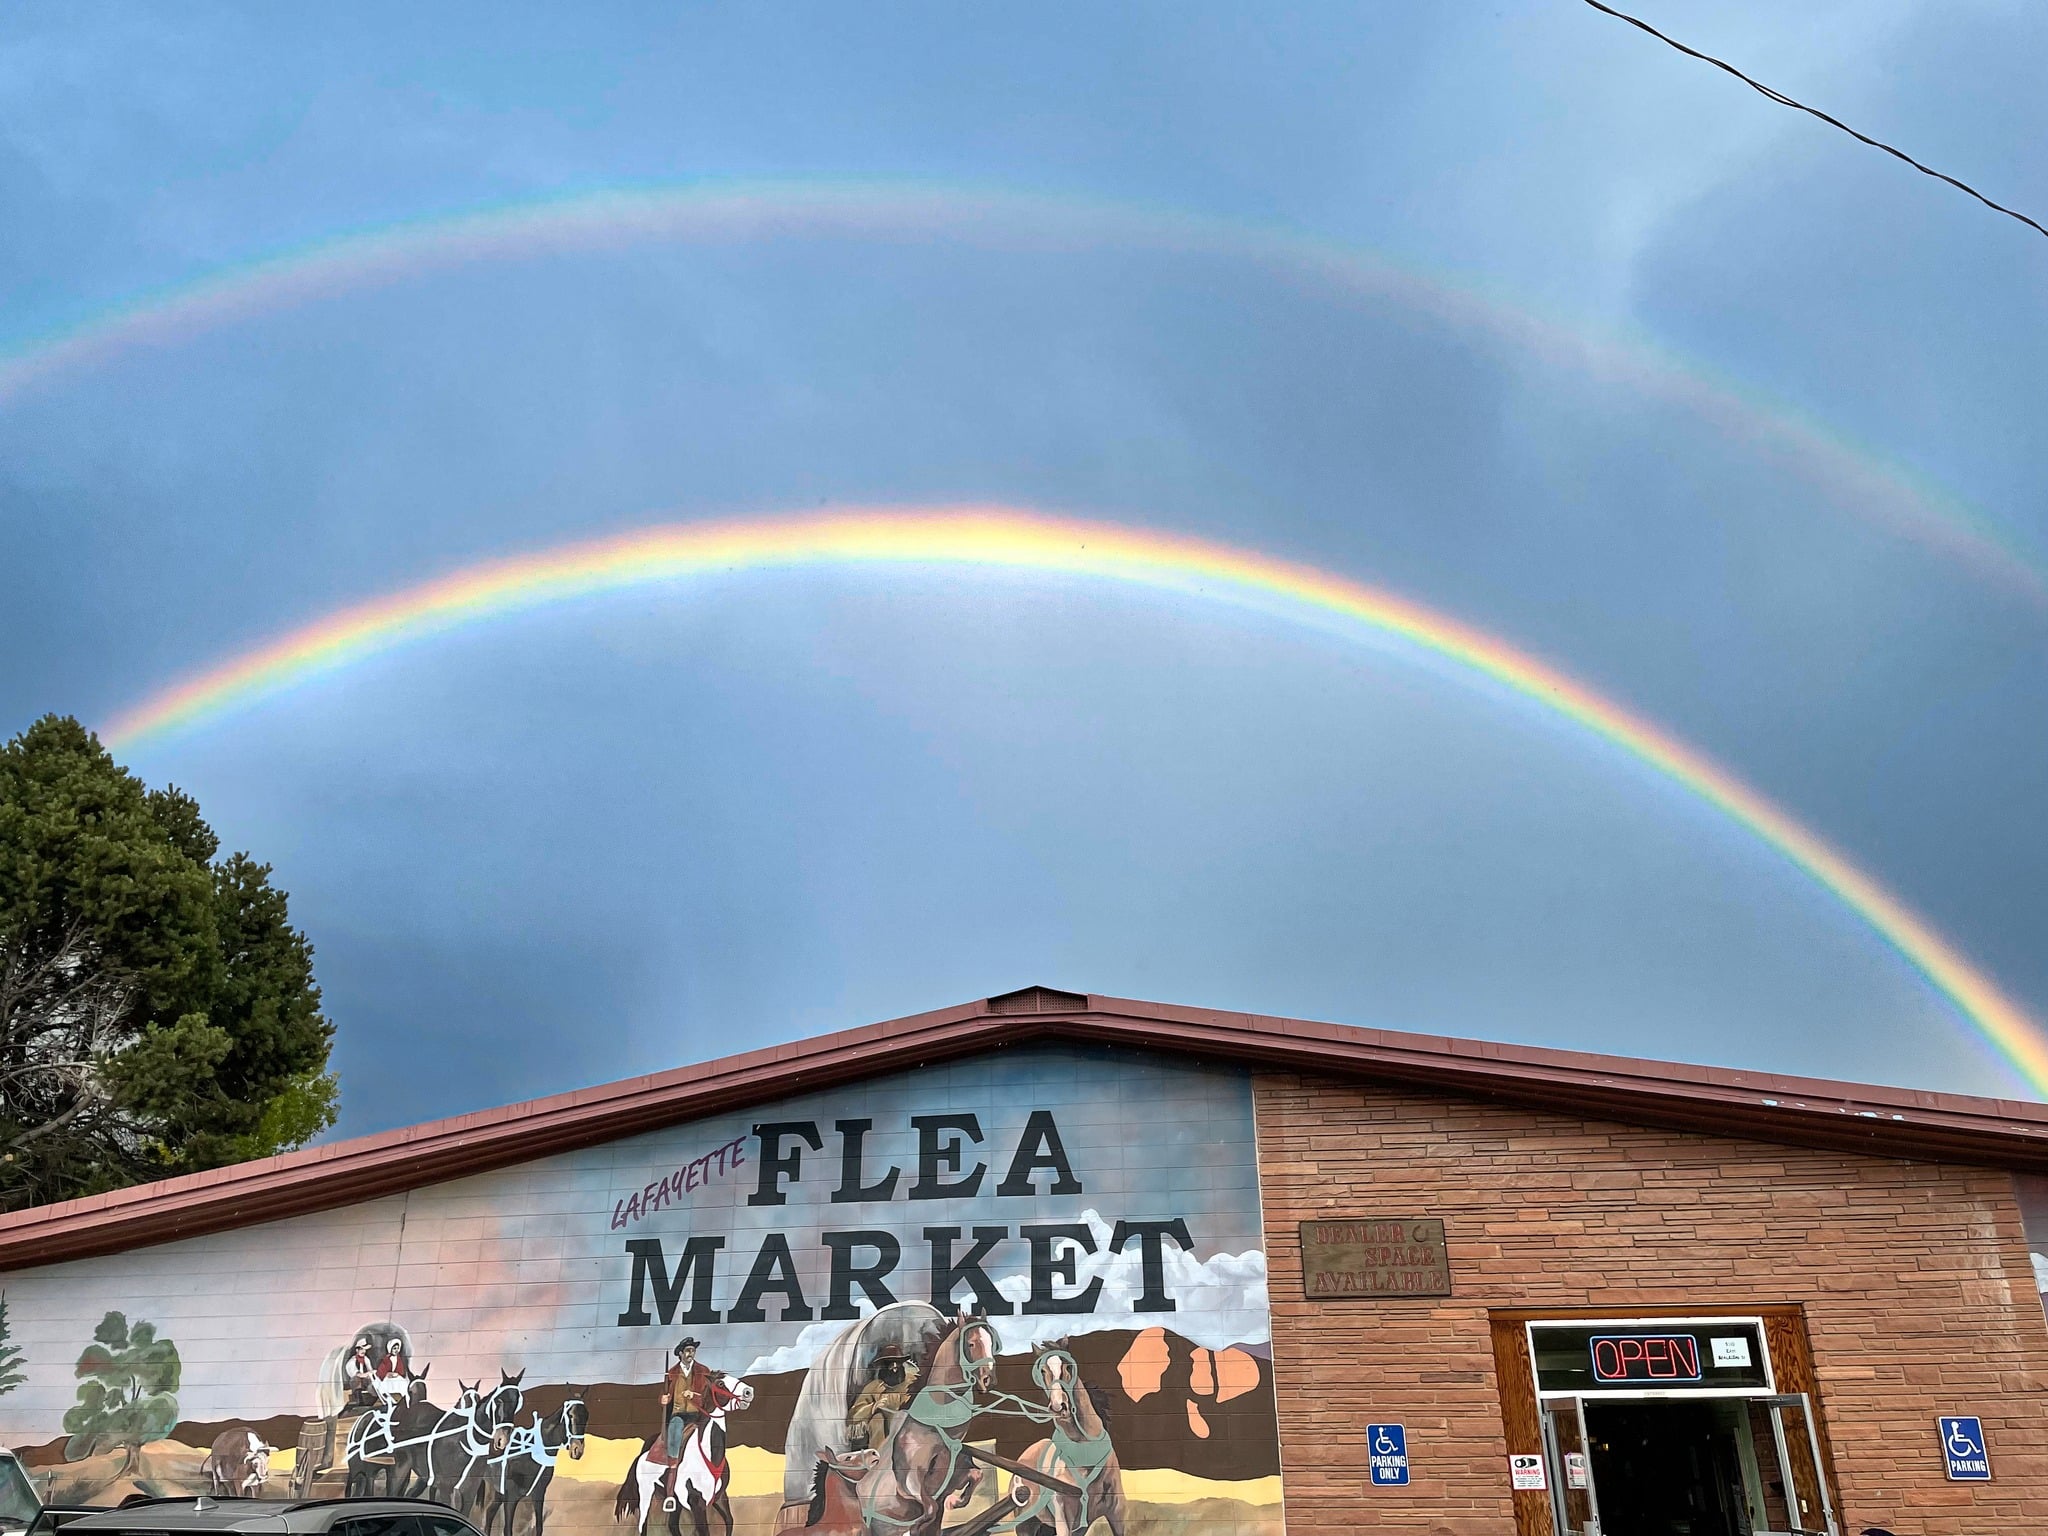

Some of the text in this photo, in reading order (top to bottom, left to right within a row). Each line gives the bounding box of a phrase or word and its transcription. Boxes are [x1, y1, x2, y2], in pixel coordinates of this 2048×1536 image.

[747, 1110, 1083, 1207] FLEA
[611, 1135, 747, 1230] LAFAYETTE
[1316, 1223, 1406, 1245] DEALER
[1364, 1246, 1436, 1267] SPACE
[617, 1218, 1194, 1327] MARKET
[1314, 1270, 1445, 1292] AVAILABLE
[1595, 1338, 1697, 1378] OPEN
[1371, 1455, 1406, 1468] PARKING
[1950, 1460, 1986, 1472] PARKING
[1380, 1467, 1400, 1480] ONLY
